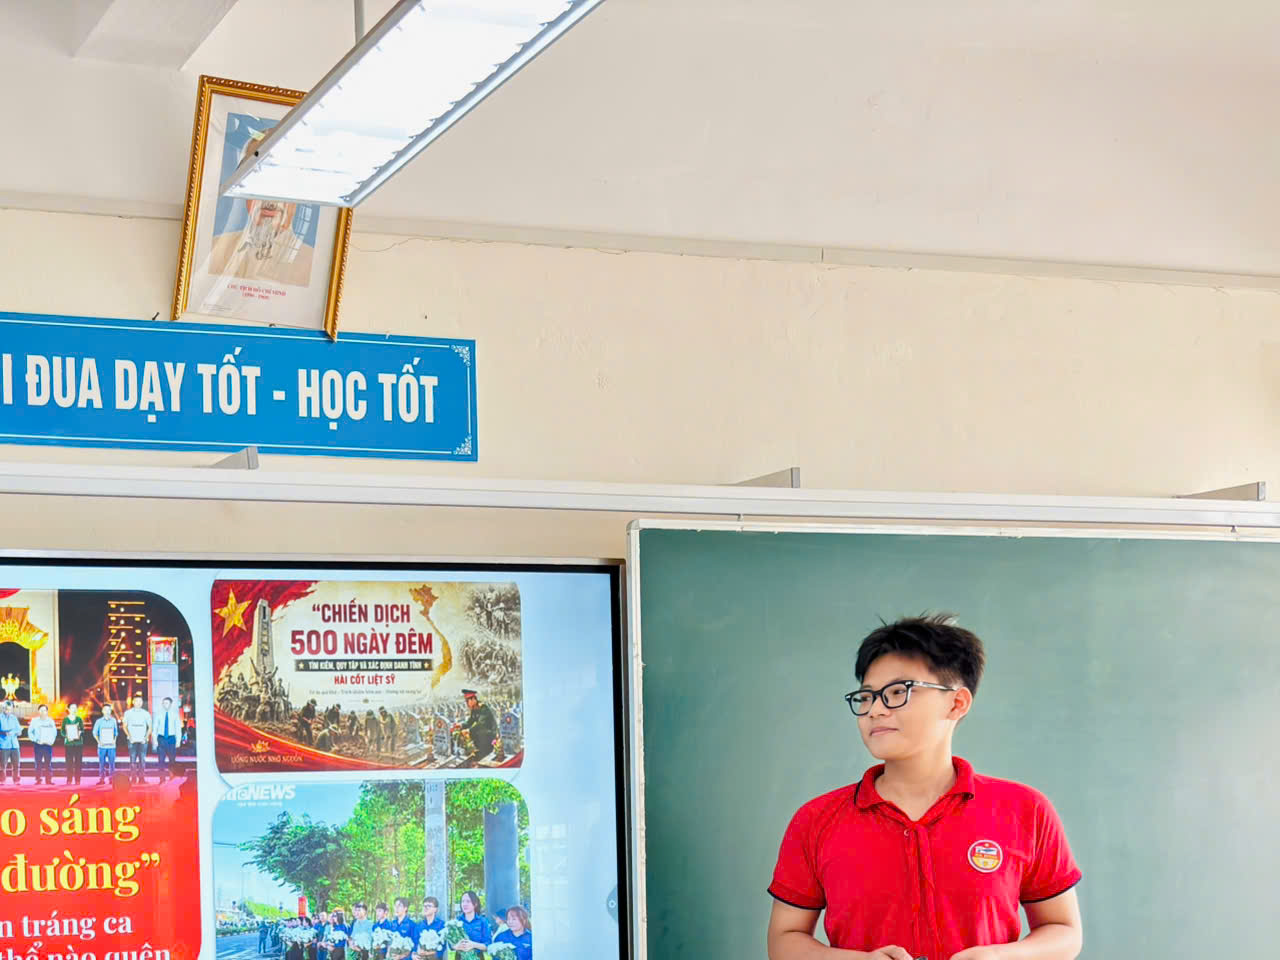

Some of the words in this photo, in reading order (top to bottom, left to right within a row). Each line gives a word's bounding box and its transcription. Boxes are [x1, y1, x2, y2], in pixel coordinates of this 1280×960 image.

[25, 354, 103, 410] ĐUA
[115, 358, 186, 423] DẠY
[196, 346, 261, 416] TỐT
[297, 368, 368, 431] HỌC
[378, 357, 439, 424] TỐT
[374, 604, 410, 628] DỊCH
[290, 629, 338, 655] 500
[344, 627, 390, 654] NGÀY
[395, 627, 433, 654] ĐÊM
[334, 674, 348, 685] HÀI
[350, 673, 365, 685] CỐT
[367, 674, 384, 687] LIỆT
[39, 793, 142, 841] sáng
[22, 910, 96, 941] tráng
[103, 916, 133, 936] ca
